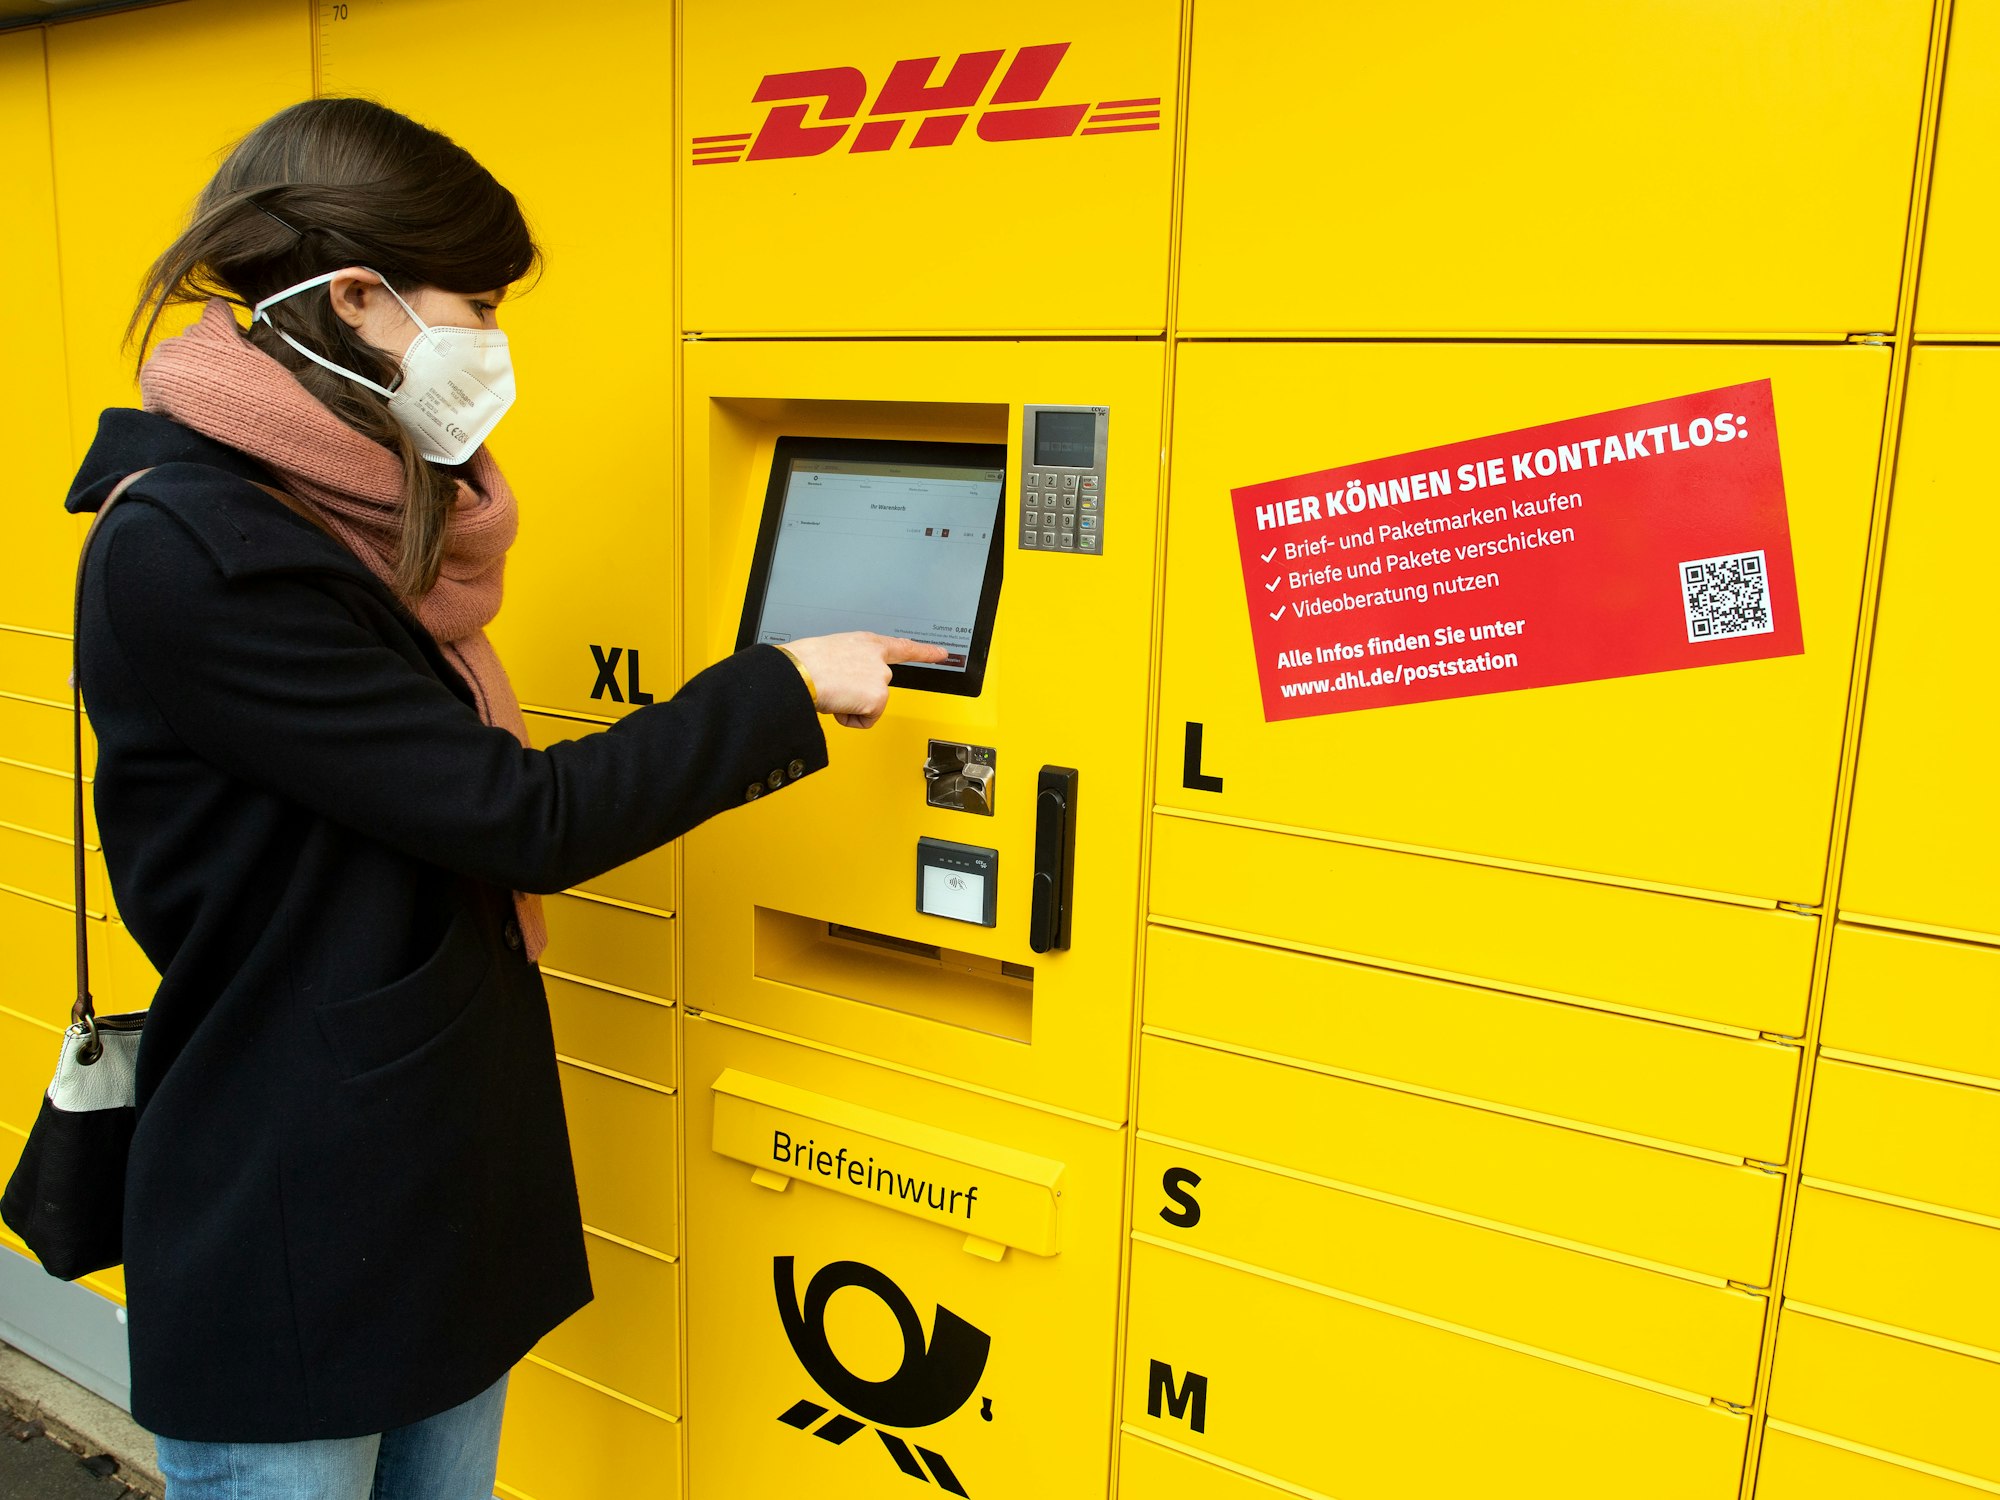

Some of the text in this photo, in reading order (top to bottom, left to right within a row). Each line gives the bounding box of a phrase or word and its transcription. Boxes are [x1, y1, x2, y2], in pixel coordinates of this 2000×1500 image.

[332, 3, 348, 21] 70
[746, 42, 1092, 162] DHL
[1048, 477, 1053, 485] 2
[1067, 478, 1072, 486] 3
[1255, 413, 1749, 531] HIER KÖNNEN SIE KONTAKTLOS:
[870, 503, 906, 512] Ihr Warenkorb
[1028, 495, 1034, 504] 4
[1047, 496, 1053, 505] 5
[1065, 497, 1071, 506] 6
[1047, 516, 1052, 524] 8
[1065, 516, 1070, 525] 9
[1045, 535, 1051, 543] 0
[1284, 492, 1584, 561] Brief- und Paketmarken kaufen
[1288, 525, 1576, 590] Briefe und Pakete verschicken
[1291, 571, 1500, 619] Videoberatung nutzen
[932, 624, 953, 632] Summe
[1277, 619, 1526, 670] Alle Infos finden Sie unter
[589, 644, 654, 706] XL
[1280, 651, 1519, 699] www.dhl.de/poststation
[1183, 722, 1223, 793] L
[773, 1130, 978, 1219] Briefeinwurf
[1159, 1168, 1201, 1228] S
[1147, 1359, 1207, 1433] M
